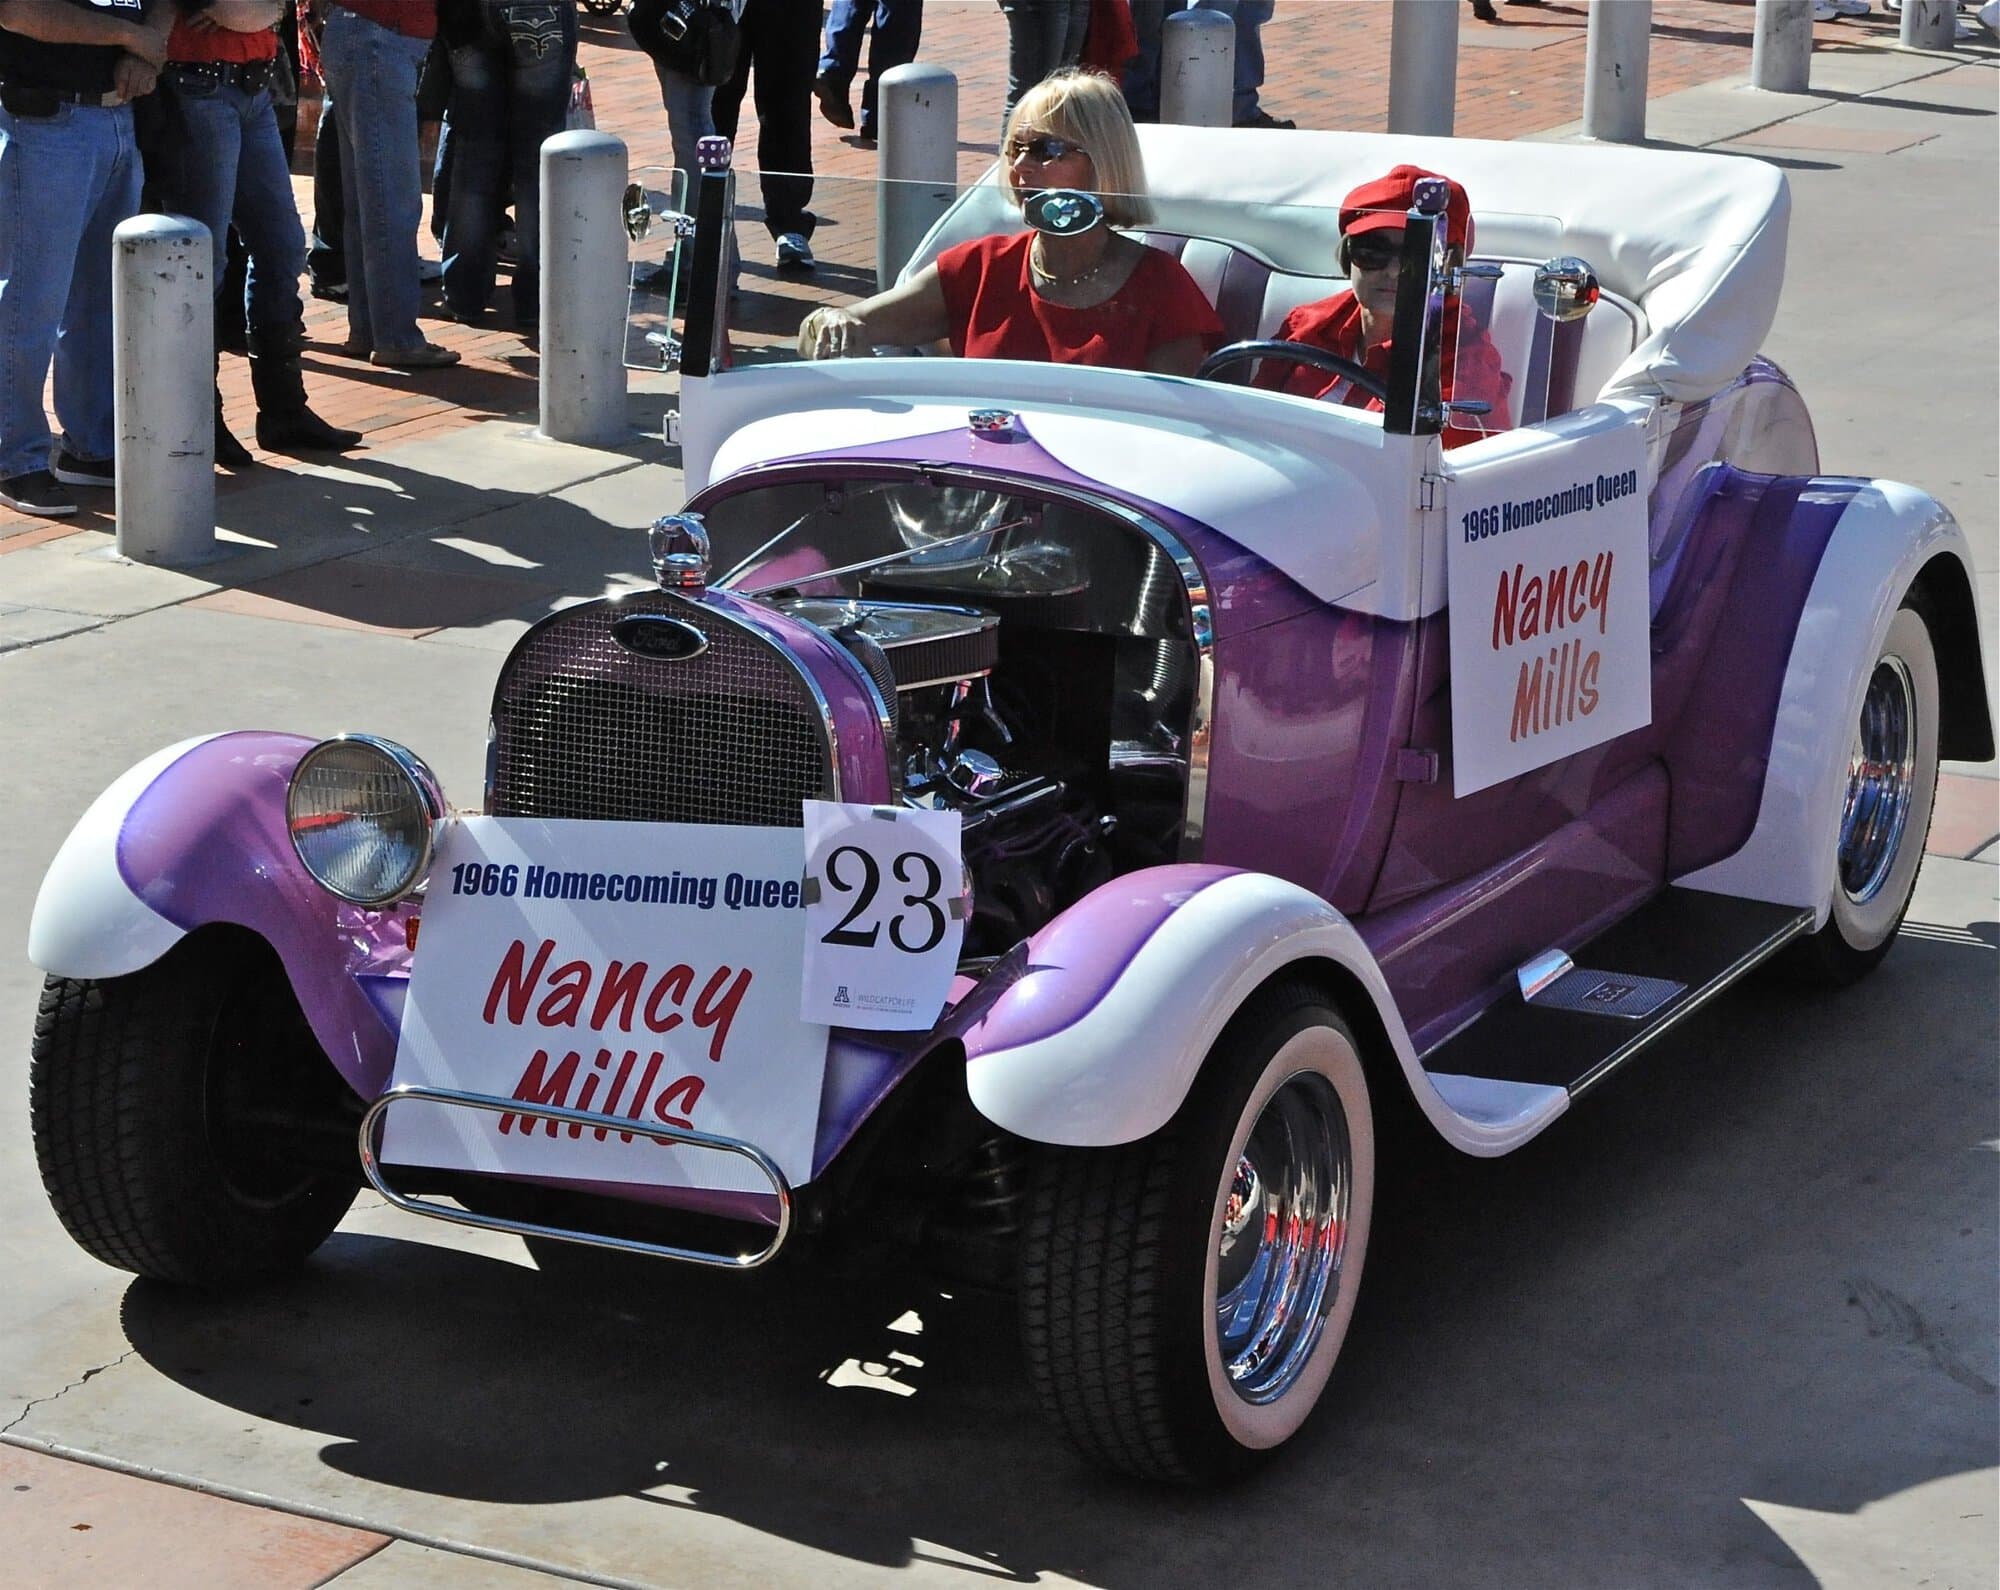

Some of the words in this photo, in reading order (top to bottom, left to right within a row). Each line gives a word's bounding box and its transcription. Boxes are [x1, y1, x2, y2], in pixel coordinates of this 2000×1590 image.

[1462, 507, 1499, 543] 1966
[1502, 484, 1593, 532] Homecoming
[1596, 470, 1636, 507] Queen
[1492, 551, 1613, 650] Nancy
[1510, 638, 1600, 742] Mills
[451, 863, 518, 896] 1966
[523, 866, 716, 909] Homecoming
[820, 845, 946, 954] 23
[482, 939, 753, 1062] Nancy
[498, 1049, 705, 1146] Mills
